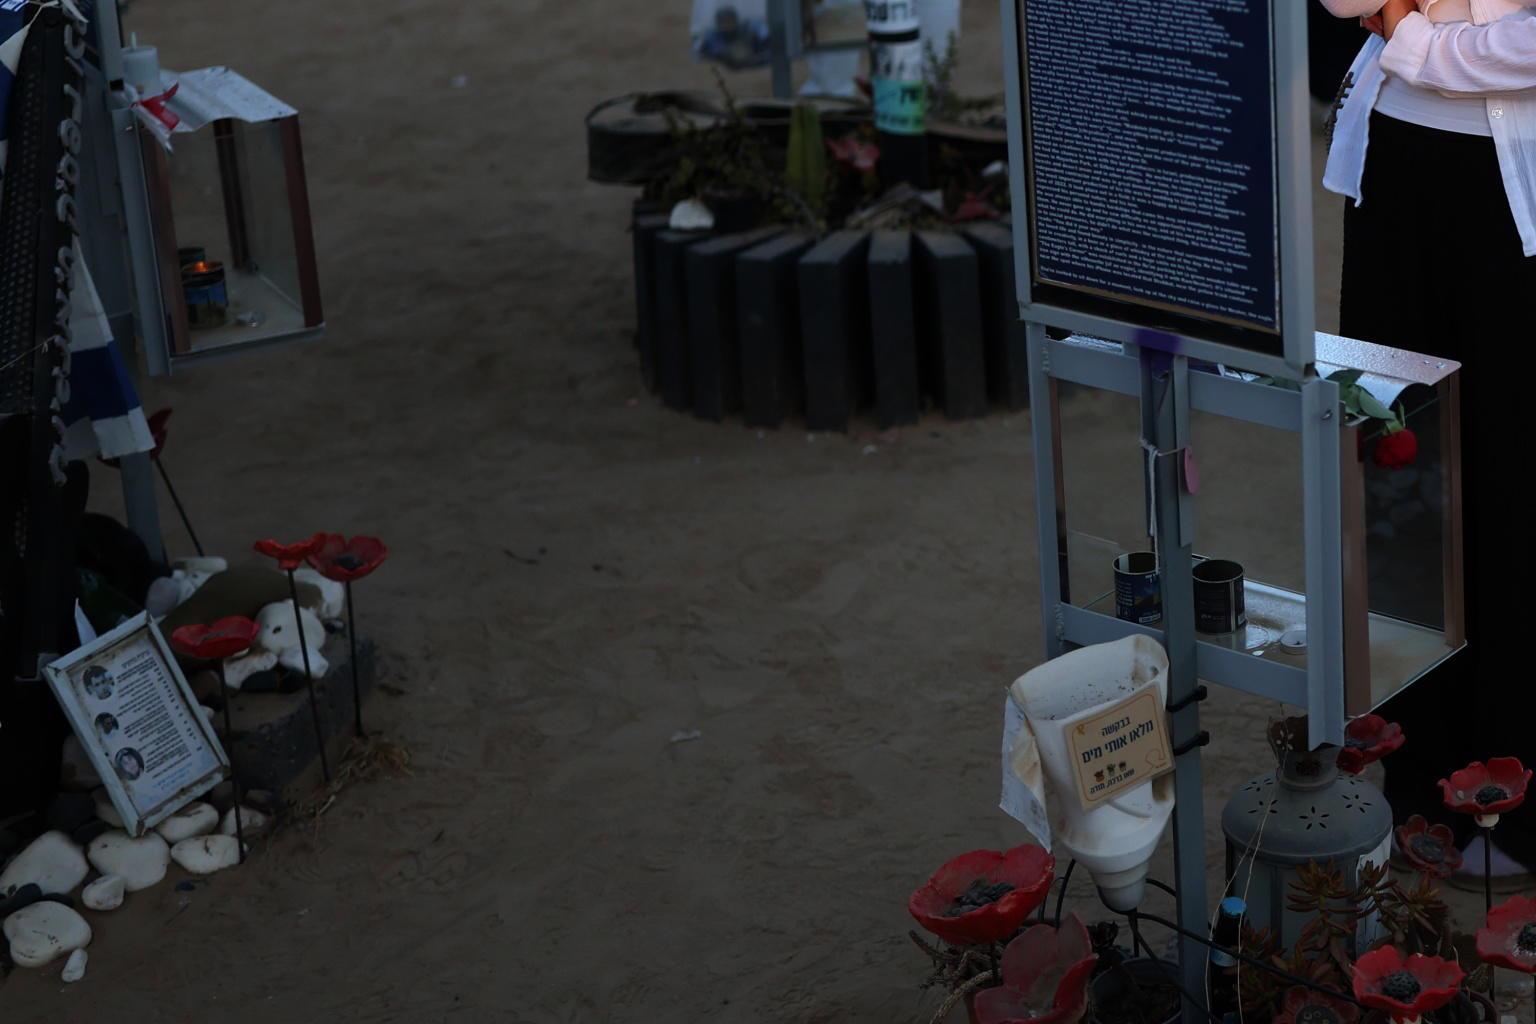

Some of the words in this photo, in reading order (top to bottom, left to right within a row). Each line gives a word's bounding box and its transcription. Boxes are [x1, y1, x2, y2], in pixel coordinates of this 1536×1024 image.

[1101, 717, 1130, 736] בבקשה
[1129, 720, 1154, 743] מלאו
[1105, 735, 1128, 753] אותי
[1081, 746, 1103, 763] מים
[1090, 782, 1106, 793] תודה
